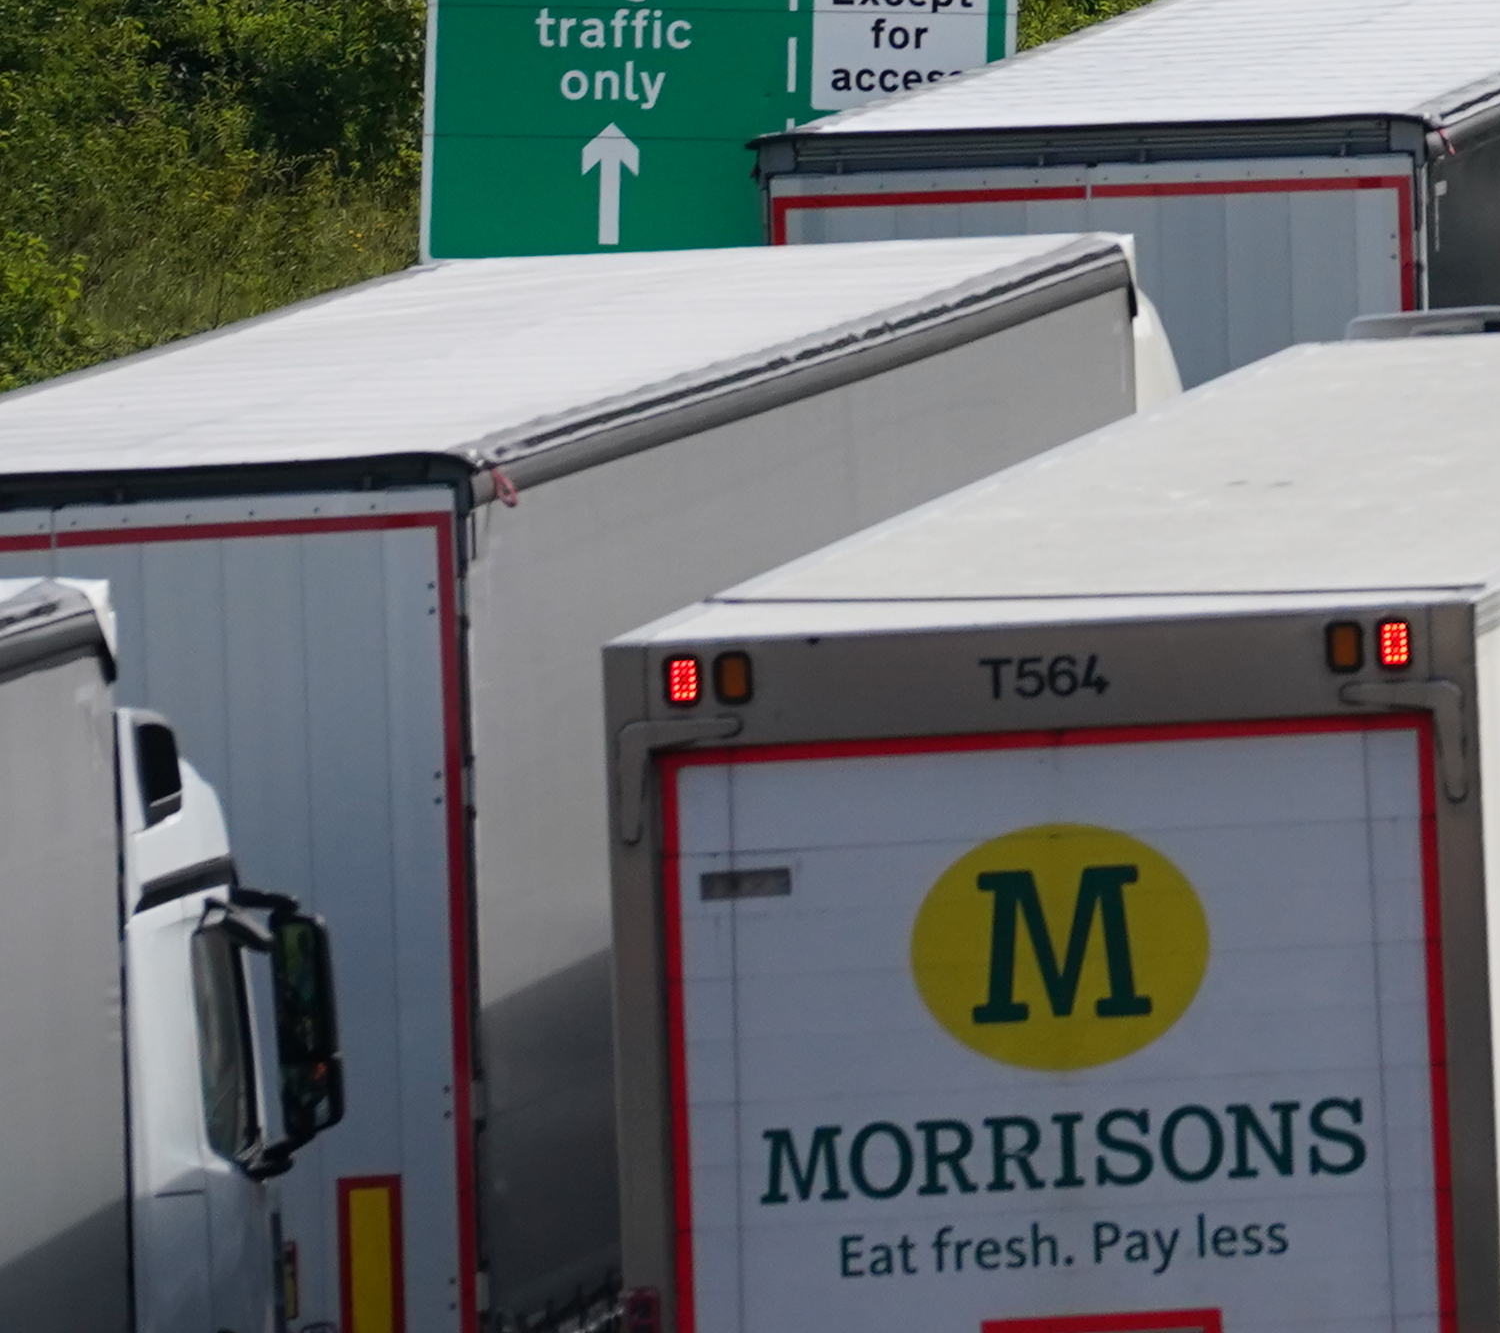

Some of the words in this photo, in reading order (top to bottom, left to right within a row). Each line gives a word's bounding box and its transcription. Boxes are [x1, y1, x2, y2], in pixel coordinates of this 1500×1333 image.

[536, 8, 692, 49] traffic
[871, 19, 928, 50] for
[560, 61, 666, 110] only
[831, 69, 963, 93] acces
[979, 655, 1109, 700] T564
[972, 865, 1152, 1025] M
[760, 1097, 1367, 1206] MORRISONS
[839, 1234, 917, 1279] Eat
[932, 1225, 1075, 1274] fresh.
[1092, 1220, 1179, 1275] Pay
[1197, 1215, 1289, 1258] less
